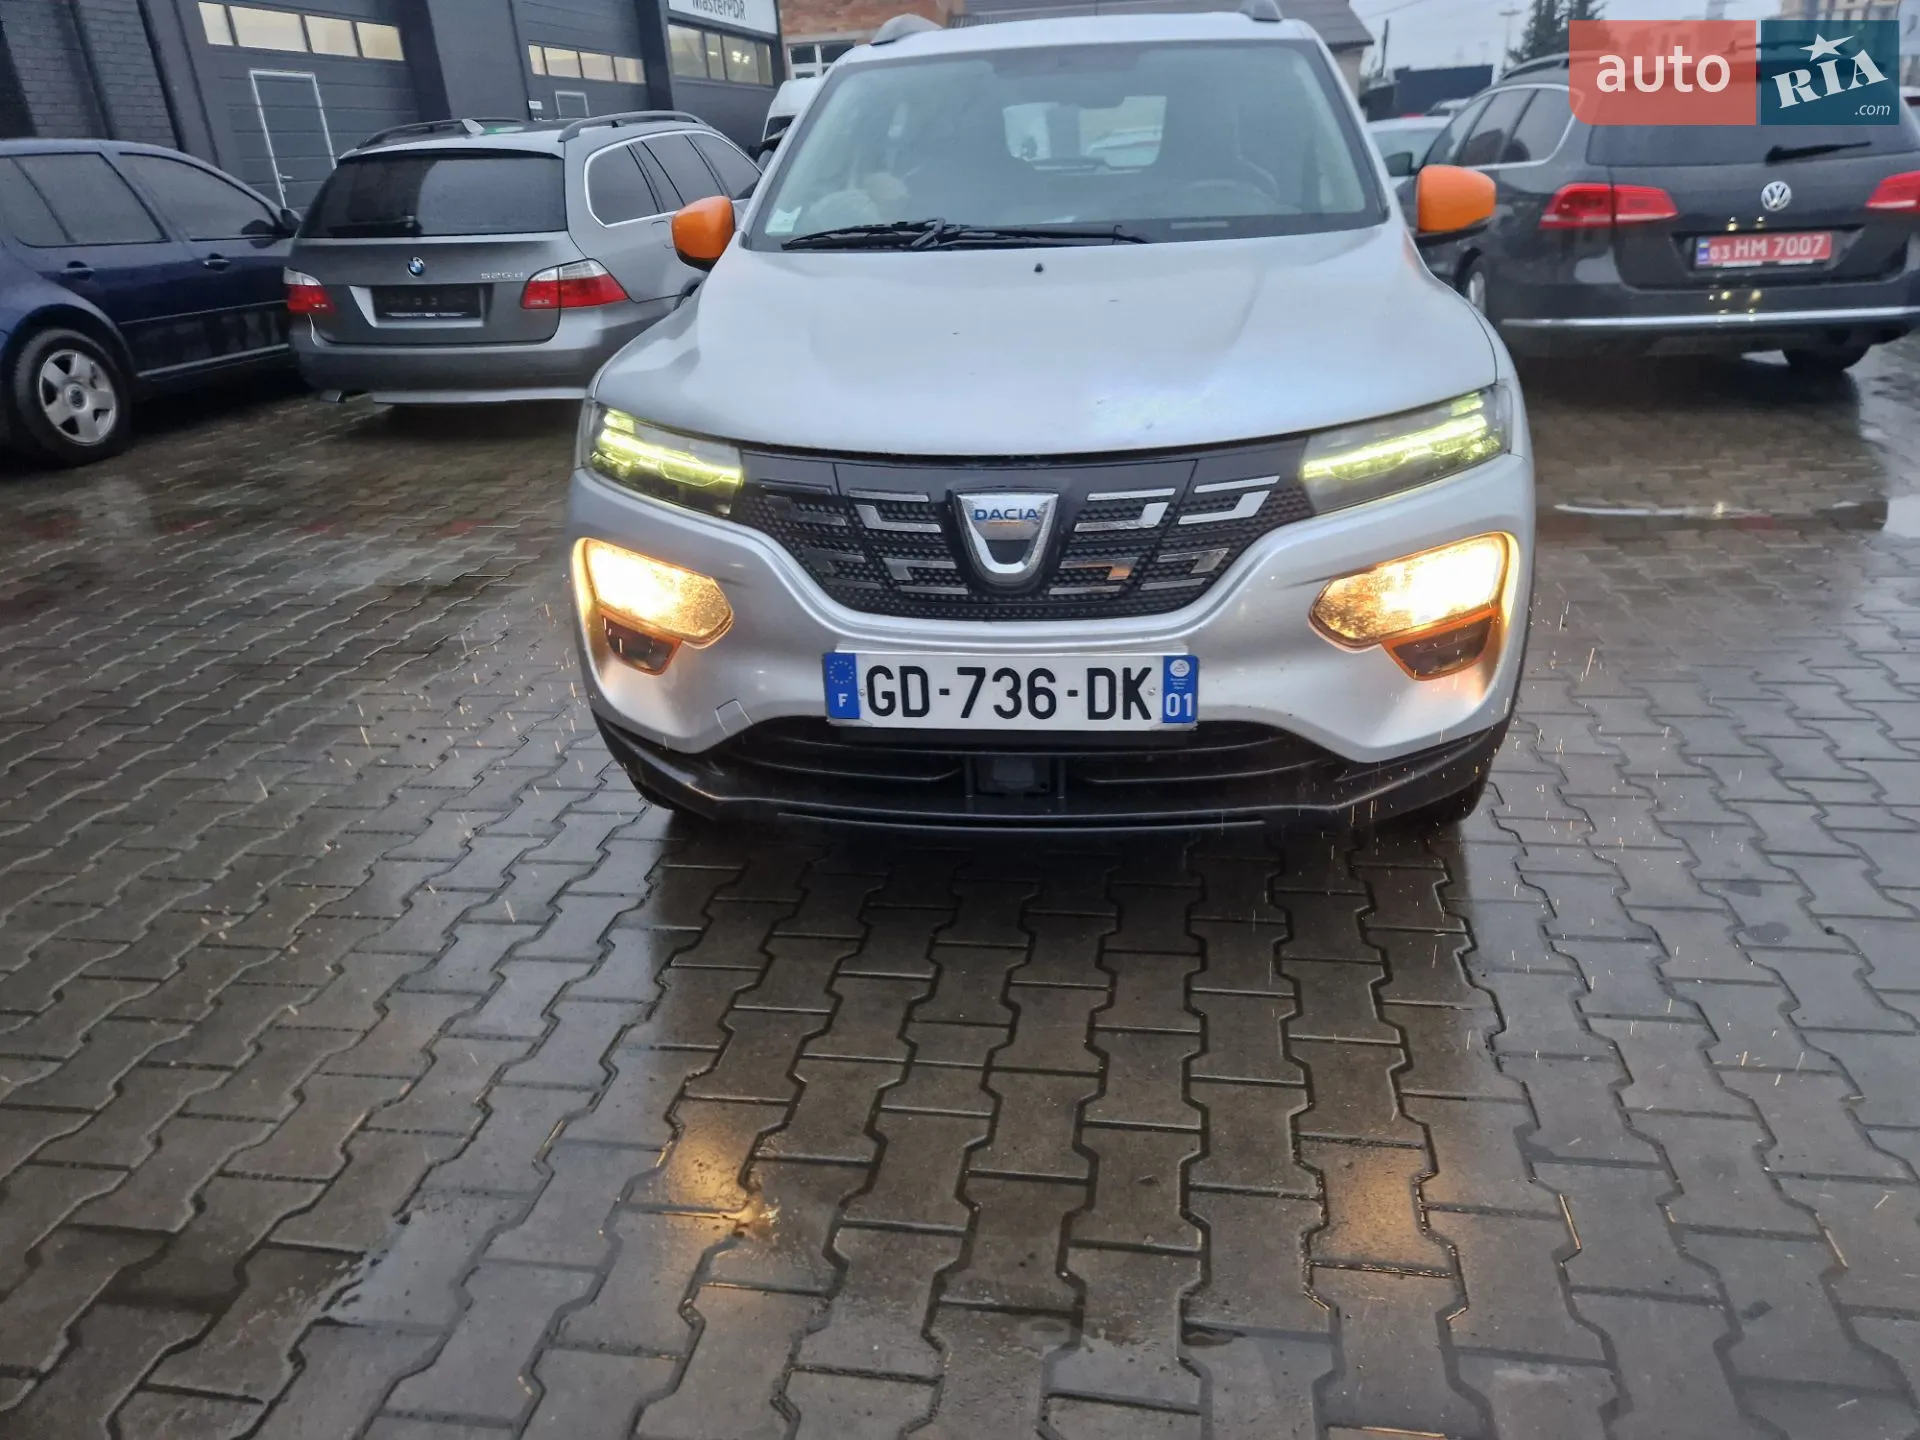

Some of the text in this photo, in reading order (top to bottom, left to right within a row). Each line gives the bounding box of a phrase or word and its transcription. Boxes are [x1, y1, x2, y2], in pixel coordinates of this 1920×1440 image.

[1709, 234, 1826, 260] 03 HM 7007
[974, 508, 1040, 521] DACIA
[838, 692, 849, 708] F
[866, 664, 1152, 721] GD-736-DK
[1165, 692, 1193, 717] 01
